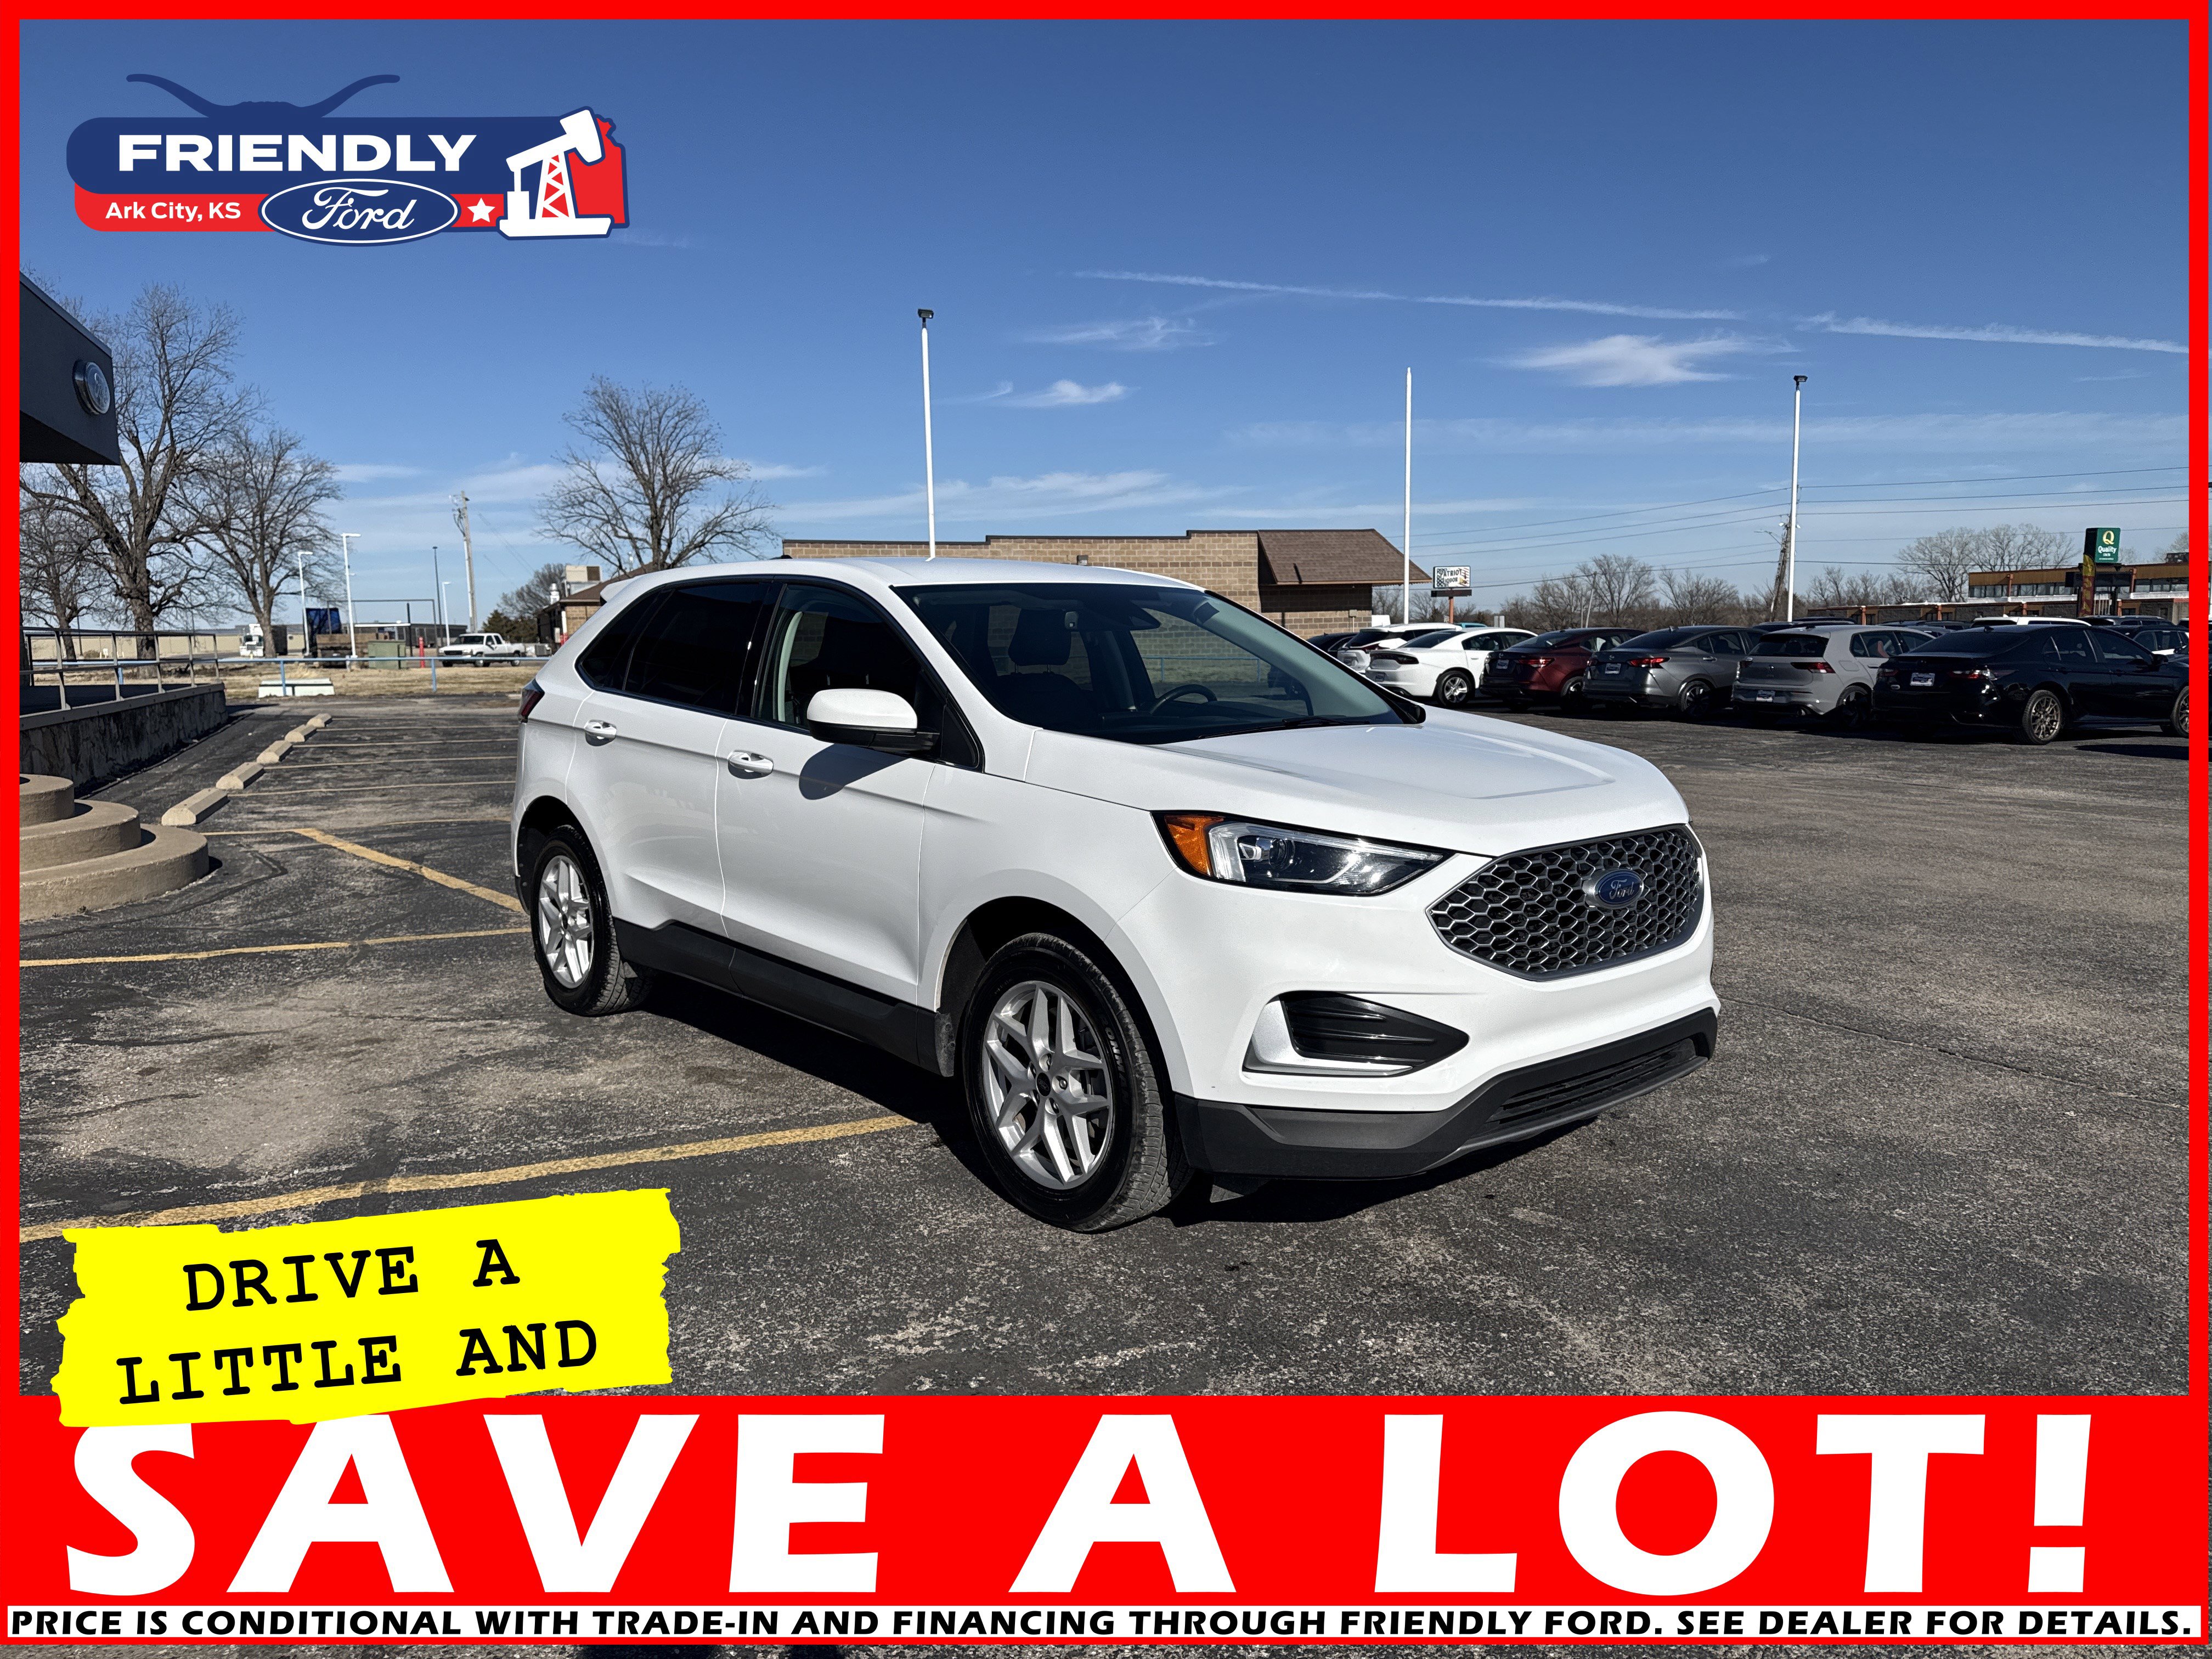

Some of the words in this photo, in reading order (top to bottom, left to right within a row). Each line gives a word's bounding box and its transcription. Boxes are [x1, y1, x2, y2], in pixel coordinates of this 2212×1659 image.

[2103, 531, 2114, 544] Q
[1440, 569, 1462, 578] PATRIOT
[1609, 879, 1634, 899] Ford
